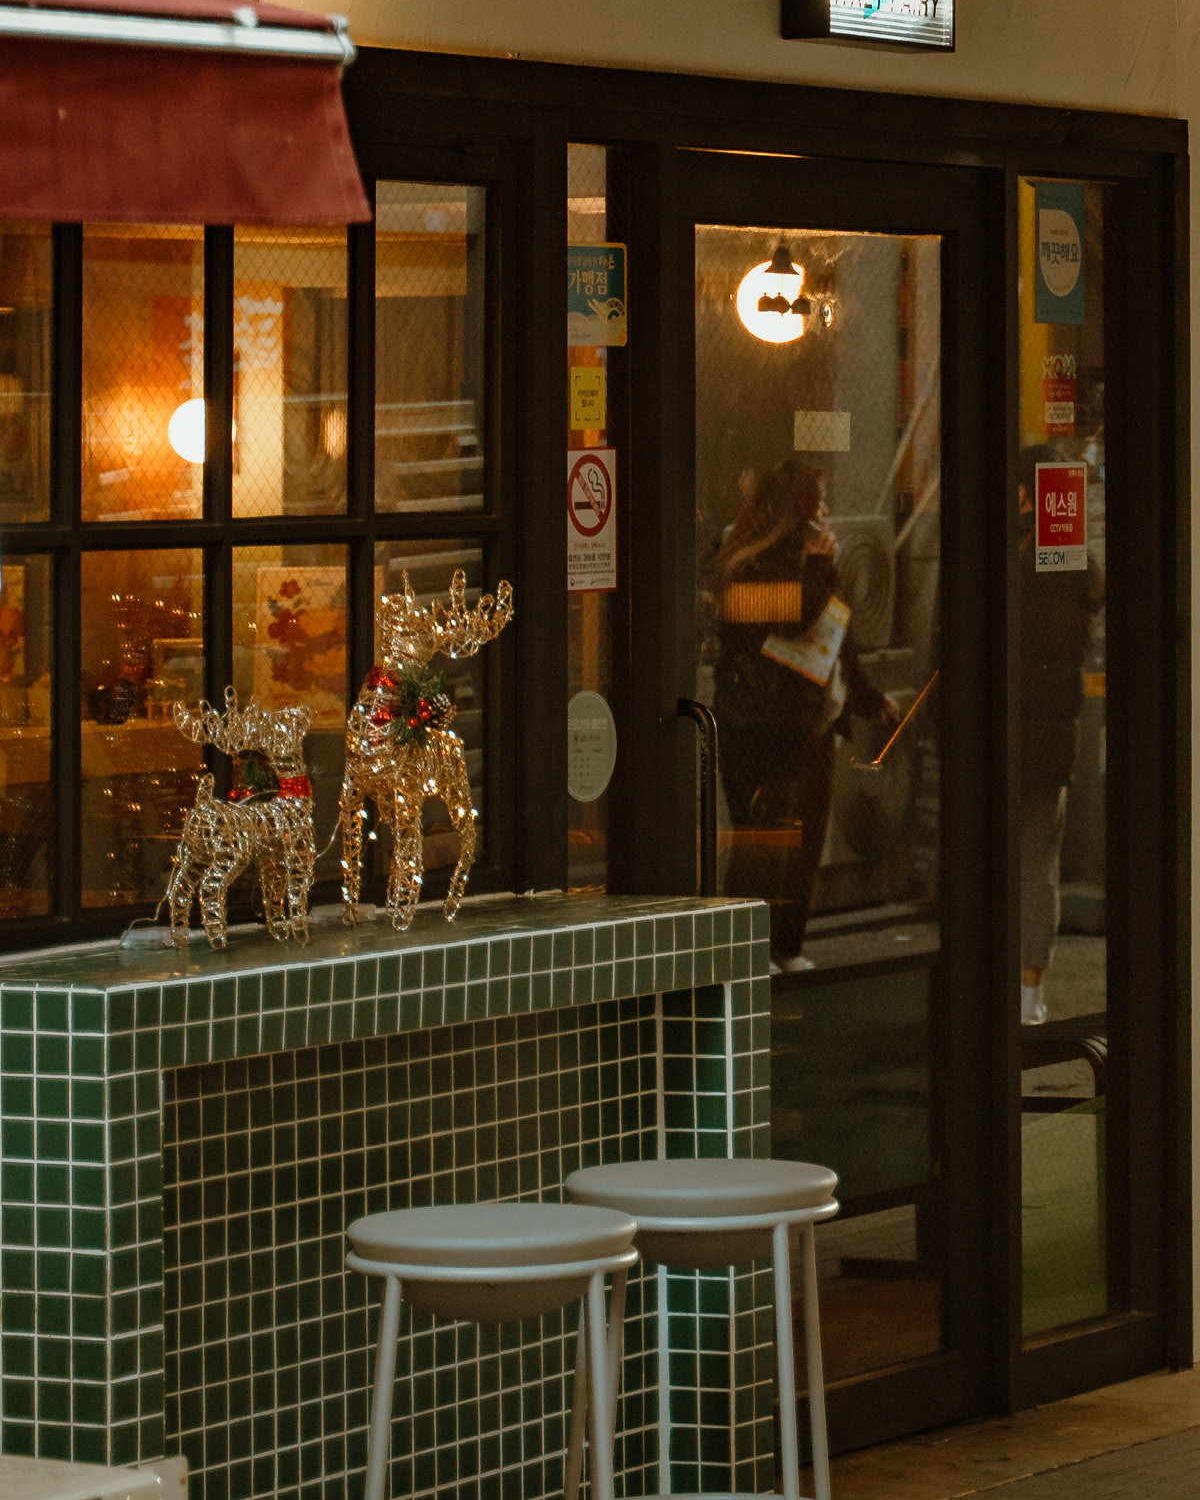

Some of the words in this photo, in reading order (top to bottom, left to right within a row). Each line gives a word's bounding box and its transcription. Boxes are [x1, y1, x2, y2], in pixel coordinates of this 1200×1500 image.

[1041, 241, 1079, 264] 깨끗해요
[568, 270, 608, 295] 가맹점
[1045, 492, 1077, 517] 에스원
[1038, 551, 1065, 566] SECOM
